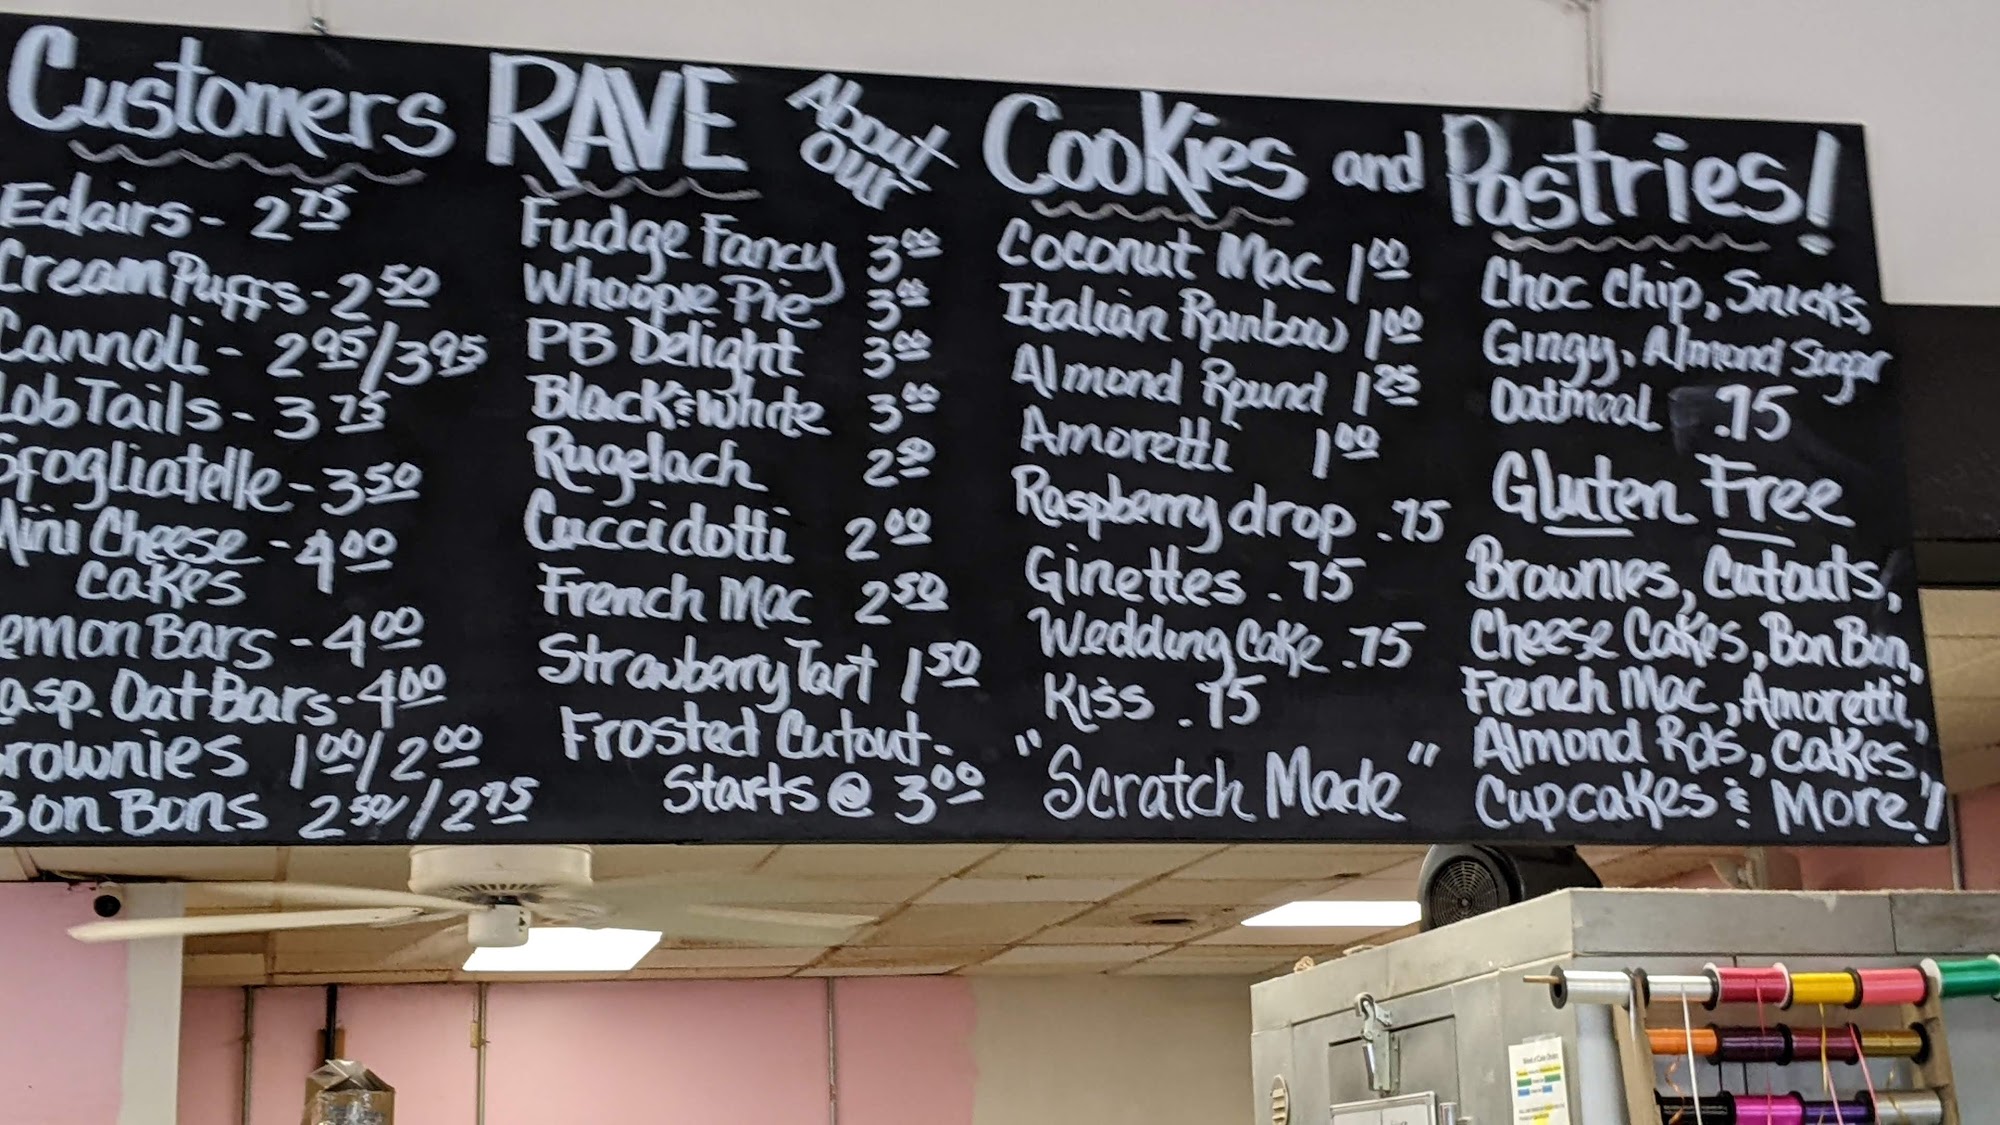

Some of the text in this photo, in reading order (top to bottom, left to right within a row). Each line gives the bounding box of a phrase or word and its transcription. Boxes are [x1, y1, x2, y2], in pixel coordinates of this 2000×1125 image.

[8, 25, 749, 187] Customers RAVE
[785, 73, 960, 192] About
[800, 130, 915, 210] Our
[982, 90, 1842, 257] Cookies and Pastries!
[521, 196, 693, 282] Fudge
[701, 213, 846, 305] Fancy
[997, 217, 1204, 280] Coconut
[1216, 231, 1336, 294] Mac
[1481, 255, 1593, 313] Choc
[720, 274, 822, 329] Pie
[999, 282, 1172, 343] Italian
[1179, 287, 1350, 354] Rainbow
[526, 317, 617, 365] PB
[626, 316, 805, 396] Delight
[1011, 342, 1184, 405] Almond
[1200, 357, 1328, 430] Round
[1641, 321, 1786, 377] Almond
[1789, 338, 1894, 406] Sugar
[1020, 404, 1234, 473] Amoretti
[1490, 376, 1663, 433] Oatmeal
[527, 425, 768, 507] Rugelach
[1492, 448, 1856, 528] Gluten Free
[90, 506, 264, 564] Cheese
[1011, 464, 1223, 554] Raspberry
[1227, 483, 1357, 555] drop
[537, 562, 708, 622] French
[720, 575, 813, 630] Mac
[1025, 542, 1247, 607] Ginettes
[0, 613, 140, 660] emon
[146, 613, 277, 669] Bars
[1027, 607, 1238, 686] Wedding
[1236, 617, 1331, 679] Cake
[1468, 607, 1619, 666] Cheese
[1759, 611, 1842, 669] Bon
[0, 677, 102, 730] asp.
[110, 668, 209, 722] Oat
[207, 666, 338, 727] Bars
[538, 632, 791, 714] Strawberry
[783, 636, 879, 704] Tart
[1043, 672, 1156, 733] Kiss
[1460, 665, 1616, 717] French
[0, 729, 249, 783] rownies
[560, 701, 760, 761] Frosted
[1473, 715, 1646, 776] Almond
[109, 788, 268, 836] Bons
[663, 761, 820, 815] Starts
[827, 771, 874, 818] @
[1476, 768, 1718, 831] Cupcakes
[1771, 780, 1947, 844] More!
